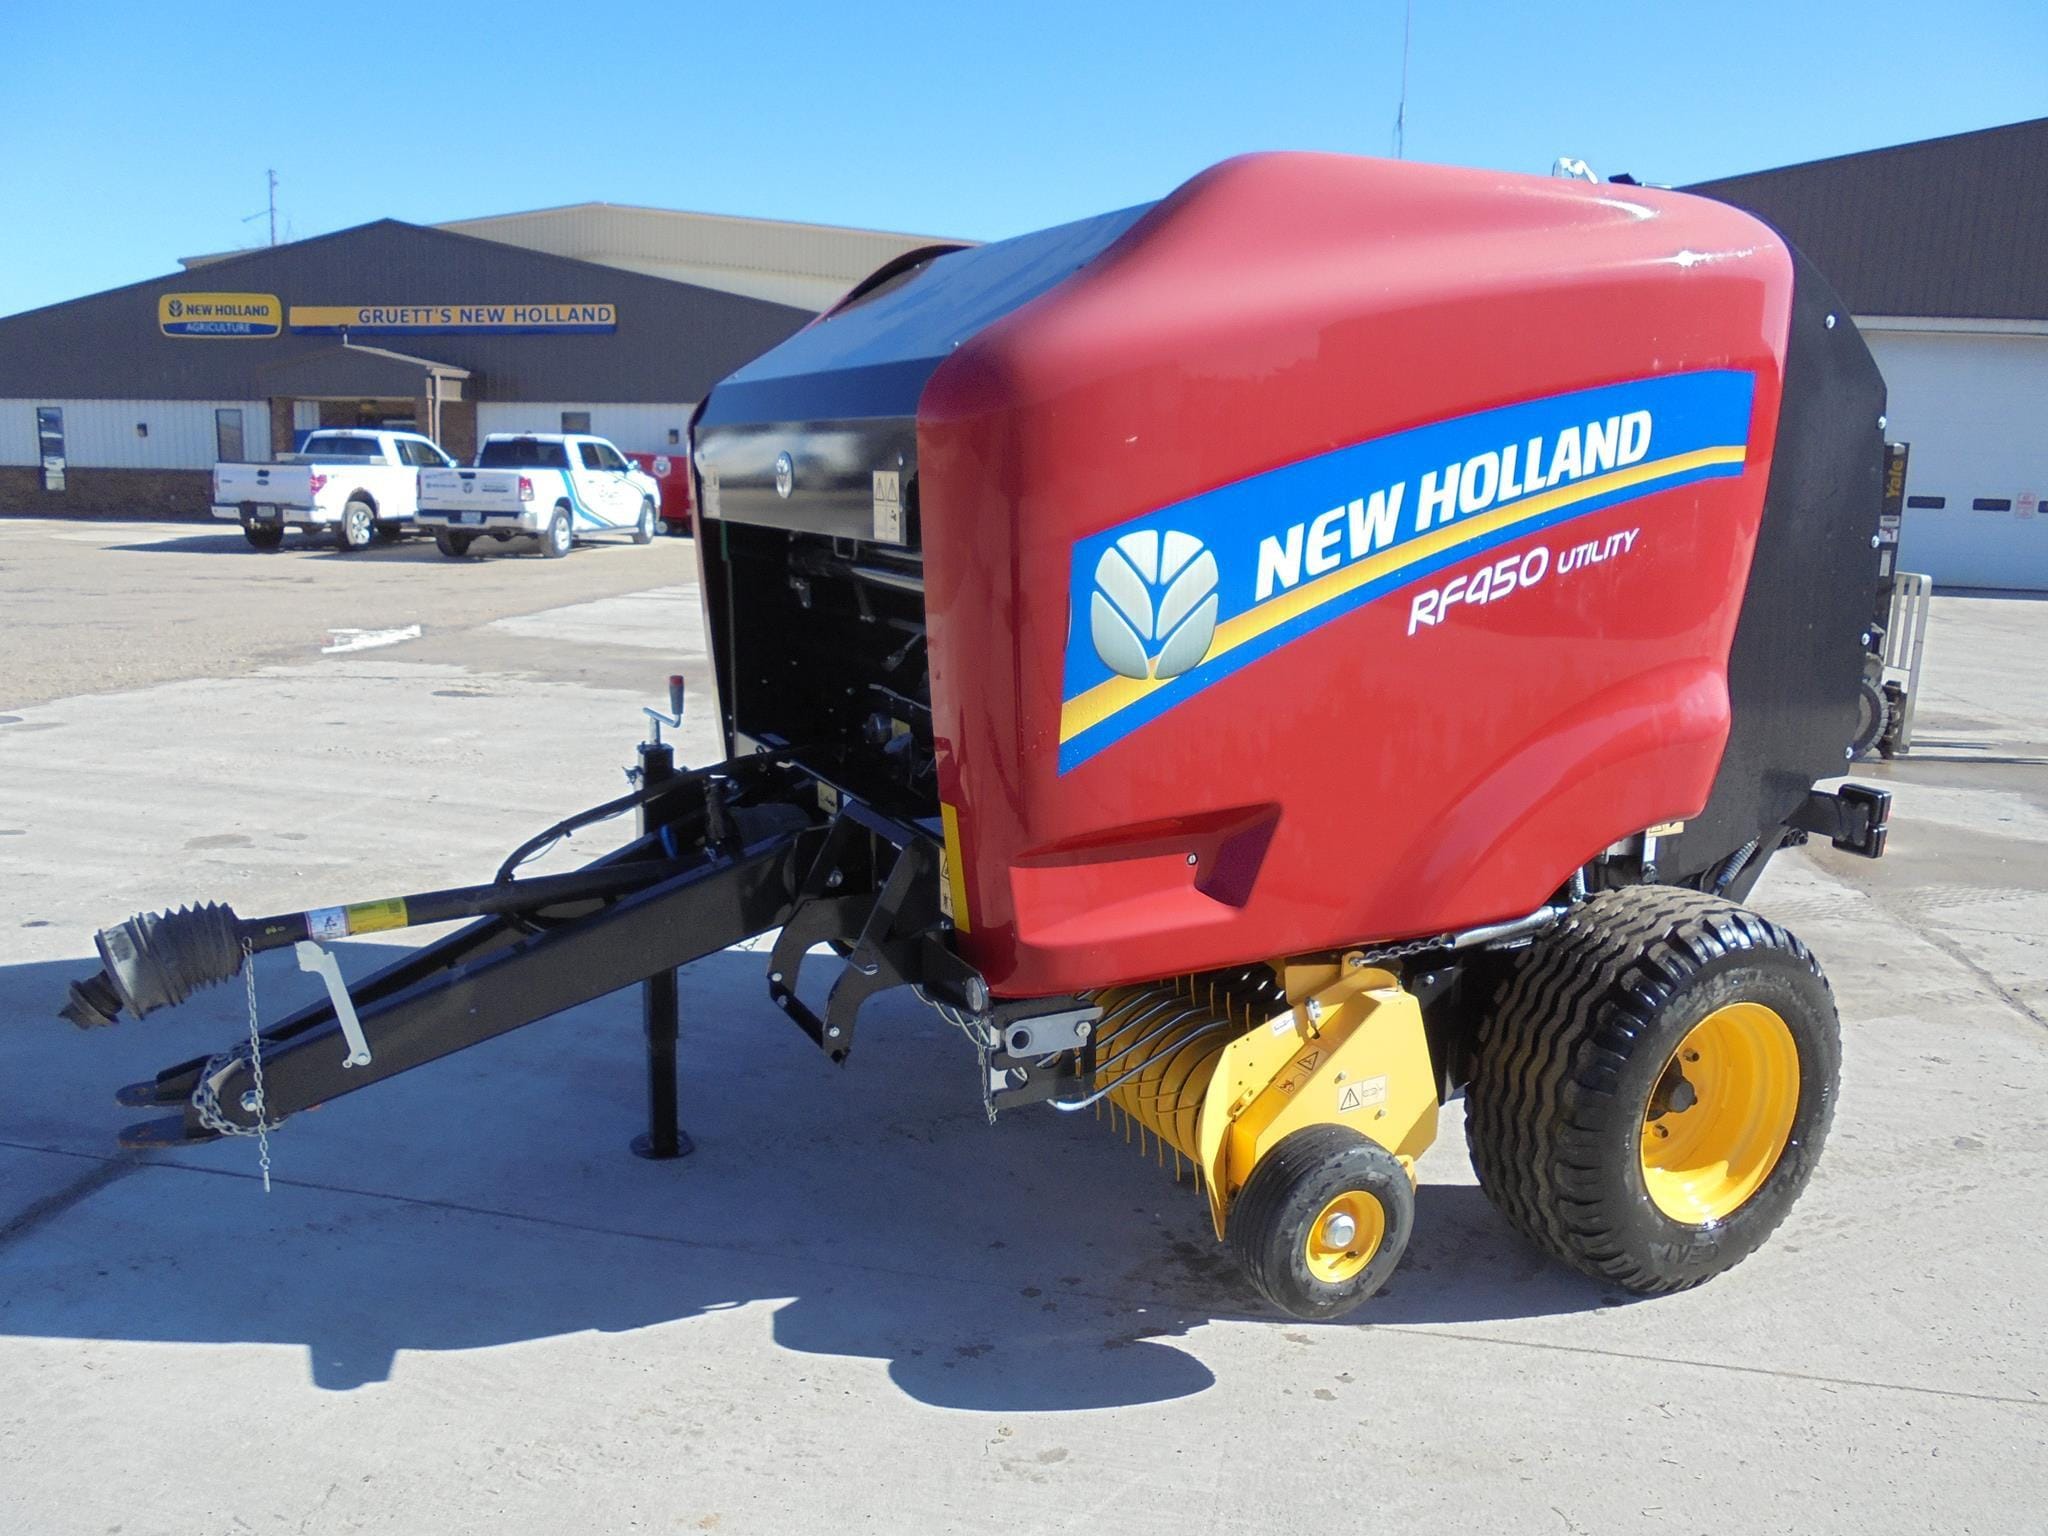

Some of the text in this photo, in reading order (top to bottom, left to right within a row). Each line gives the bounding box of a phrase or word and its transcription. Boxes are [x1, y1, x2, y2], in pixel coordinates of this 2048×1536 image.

[186, 304, 269, 317] NEW HOLLAND
[358, 306, 612, 324] GRUETT'S NEW HOLLAND
[185, 322, 251, 333] AGRICULTURE
[1885, 458, 1904, 499] Yale
[1255, 409, 1652, 602] NEW HOLLAND
[1407, 527, 1640, 637] RF450 UTILITY
